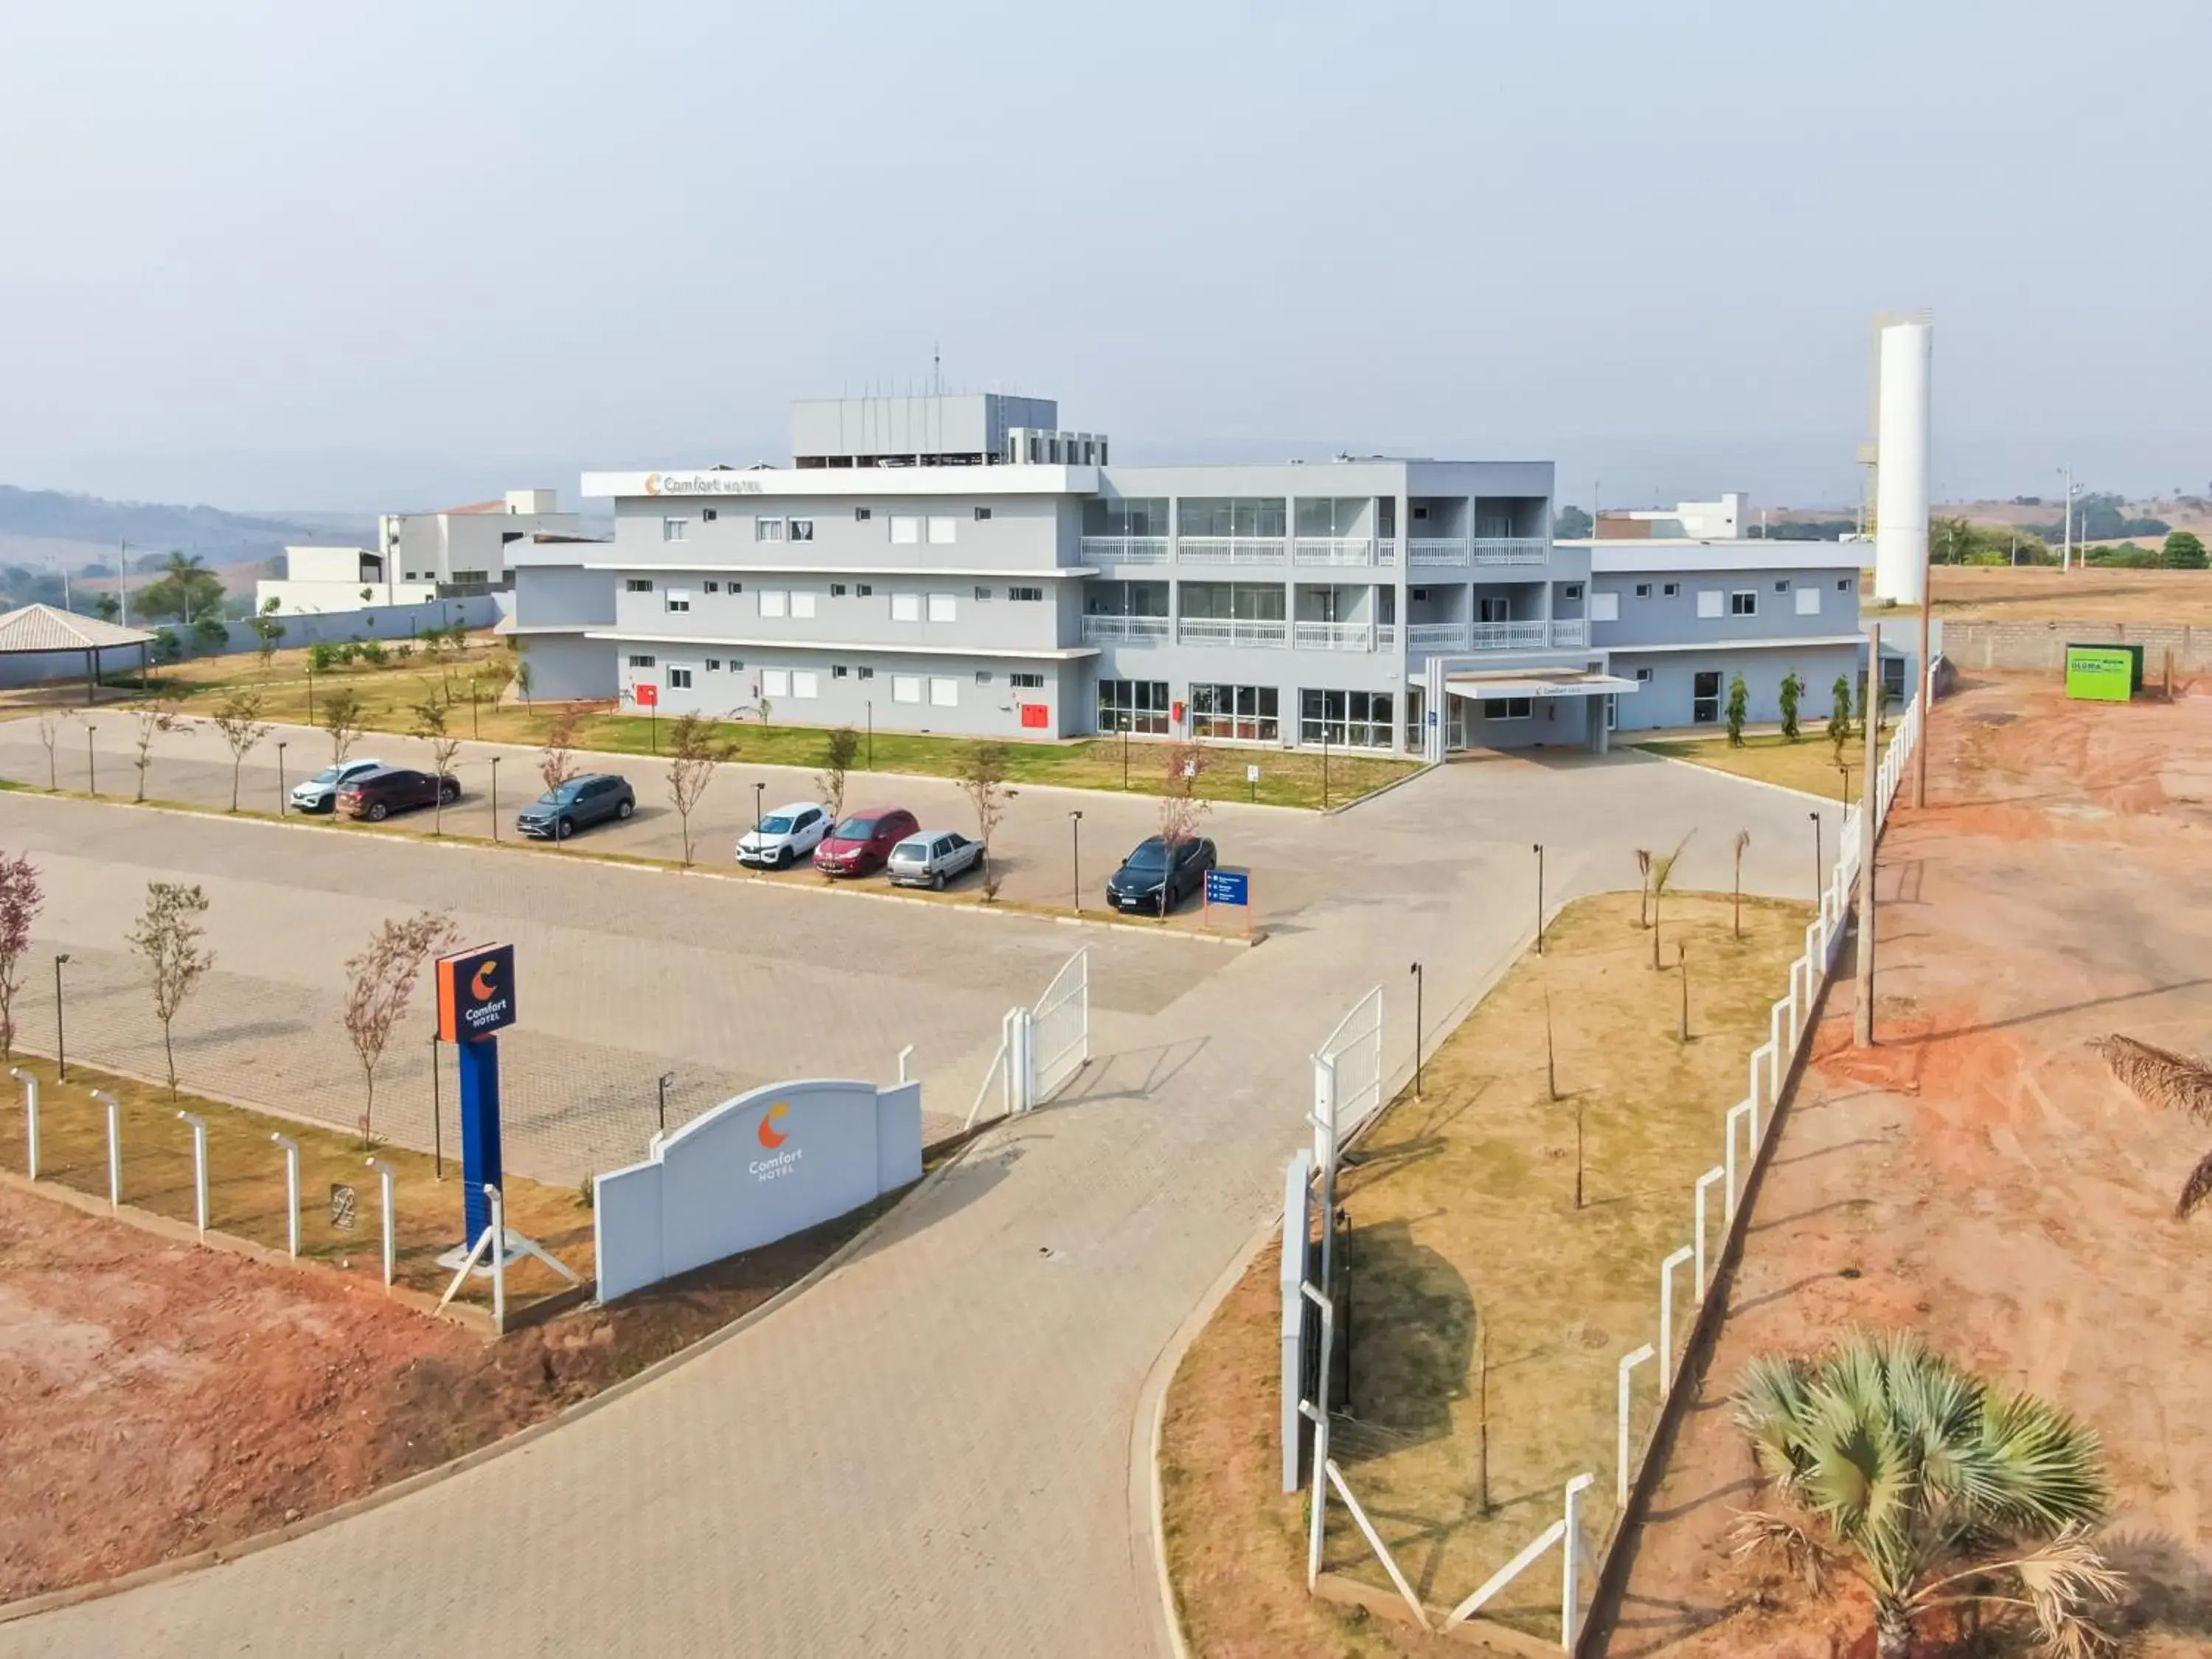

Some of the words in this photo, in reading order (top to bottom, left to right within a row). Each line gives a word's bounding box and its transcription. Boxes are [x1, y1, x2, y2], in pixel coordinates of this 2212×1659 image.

[664, 475, 722, 493] Comfort
[465, 999, 507, 1021] Comfort
[473, 1013, 501, 1027] HOTEL
[749, 1147, 803, 1175] Comfort
